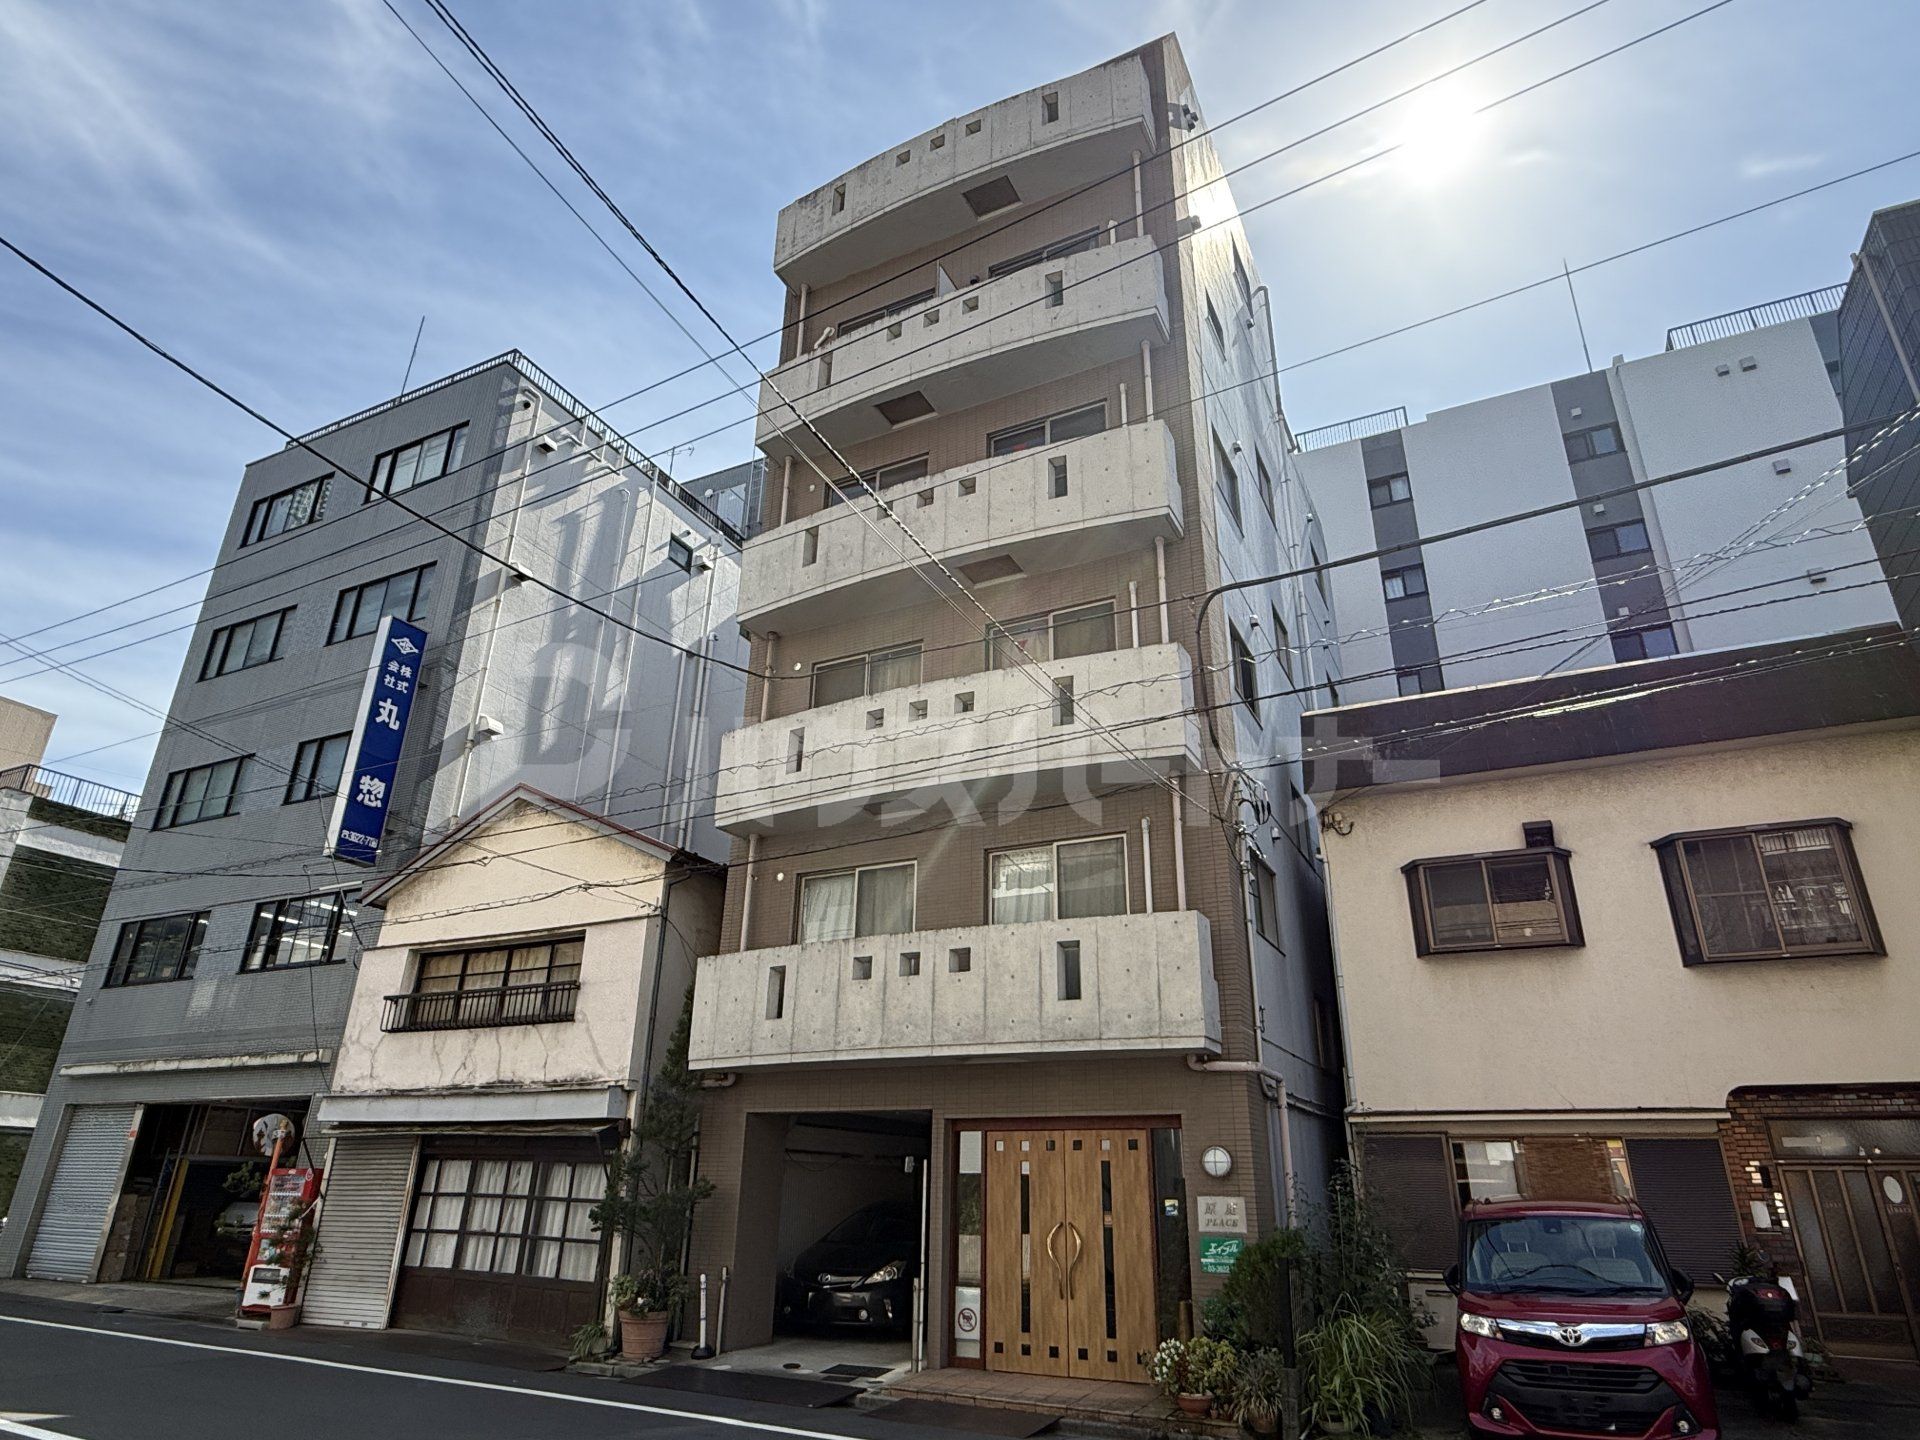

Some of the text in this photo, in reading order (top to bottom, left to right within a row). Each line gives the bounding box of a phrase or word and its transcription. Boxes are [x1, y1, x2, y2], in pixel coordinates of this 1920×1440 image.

[1205, 1217, 1239, 1228] PLACE
[1204, 1239, 1239, 1255] エイブル
